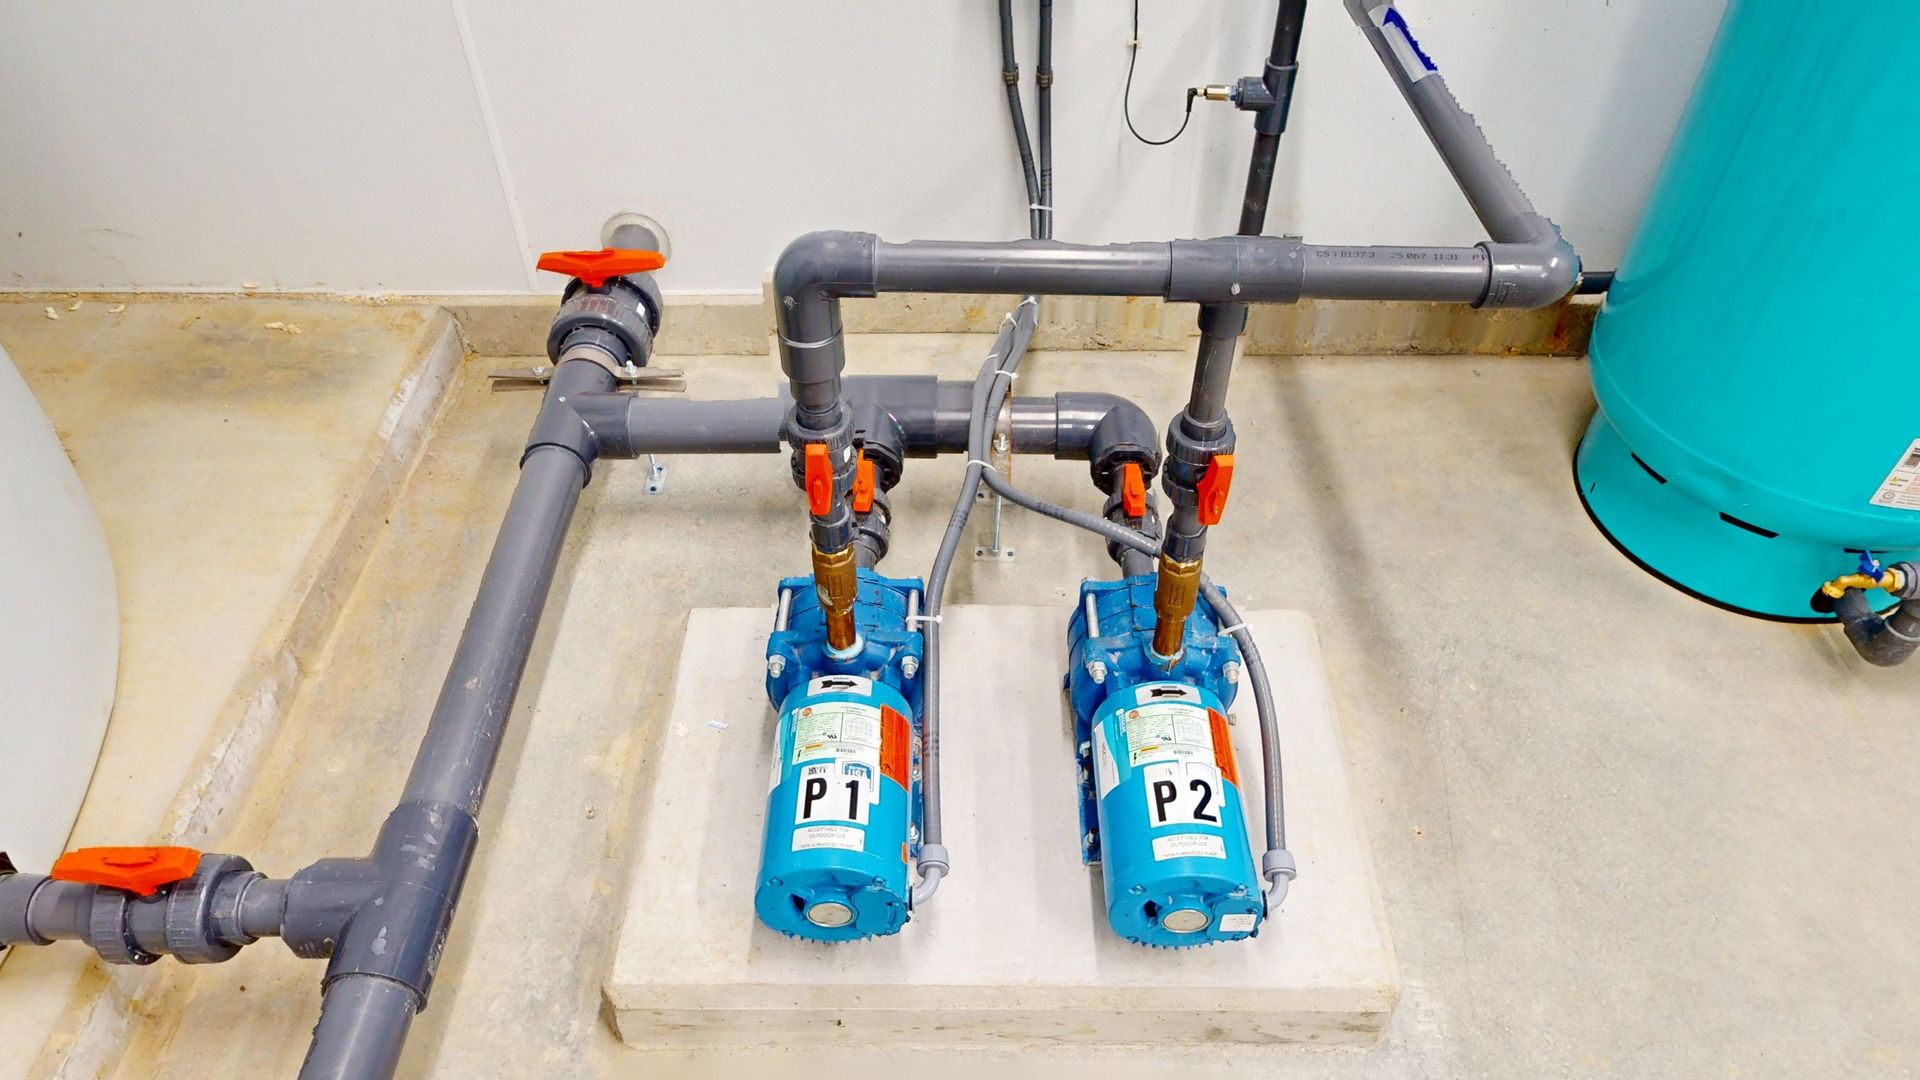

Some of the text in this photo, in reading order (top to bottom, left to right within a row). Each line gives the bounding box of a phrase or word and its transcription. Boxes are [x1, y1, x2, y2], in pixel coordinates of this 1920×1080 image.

[803, 777, 859, 820] P 1
[1153, 779, 1217, 823] P 2
